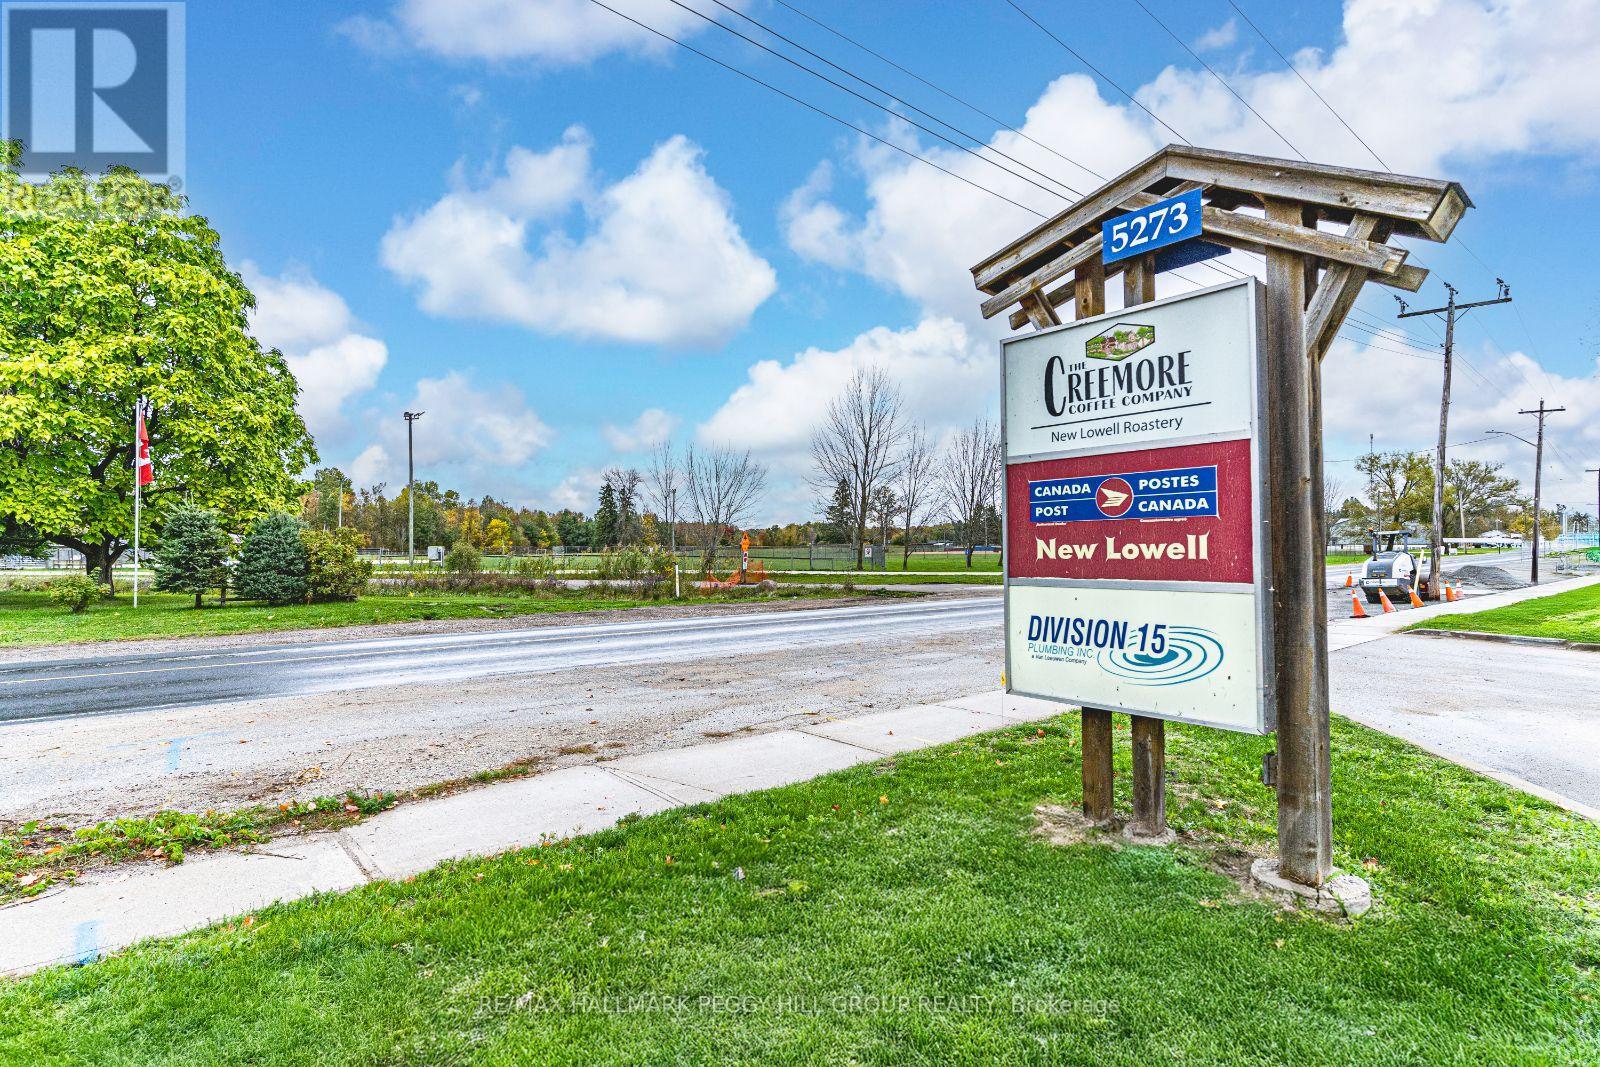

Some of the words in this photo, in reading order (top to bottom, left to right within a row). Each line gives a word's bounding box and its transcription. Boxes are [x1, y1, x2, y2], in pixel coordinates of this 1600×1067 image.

[1111, 202, 1189, 253] 5273
[1068, 361, 1087, 372] THE
[1044, 350, 1193, 417] CREEMORE
[1068, 398, 1117, 415] COFFEE
[1121, 385, 1193, 406] COMPANY
[1051, 430, 1078, 442] New
[1080, 423, 1120, 439] Lowell
[1124, 416, 1183, 433] Roastery
[1034, 483, 1091, 497] CANADA
[1138, 475, 1199, 490] POSTES
[1035, 505, 1068, 517] POST
[1138, 498, 1209, 512] CANADA
[1035, 535, 1098, 562] New
[1105, 530, 1210, 562] Lowell
[1027, 615, 1128, 650] DIVISION
[1135, 623, 1167, 654] 15
[1027, 642, 1074, 657] PLUMBING
[1076, 647, 1095, 659] INC.
